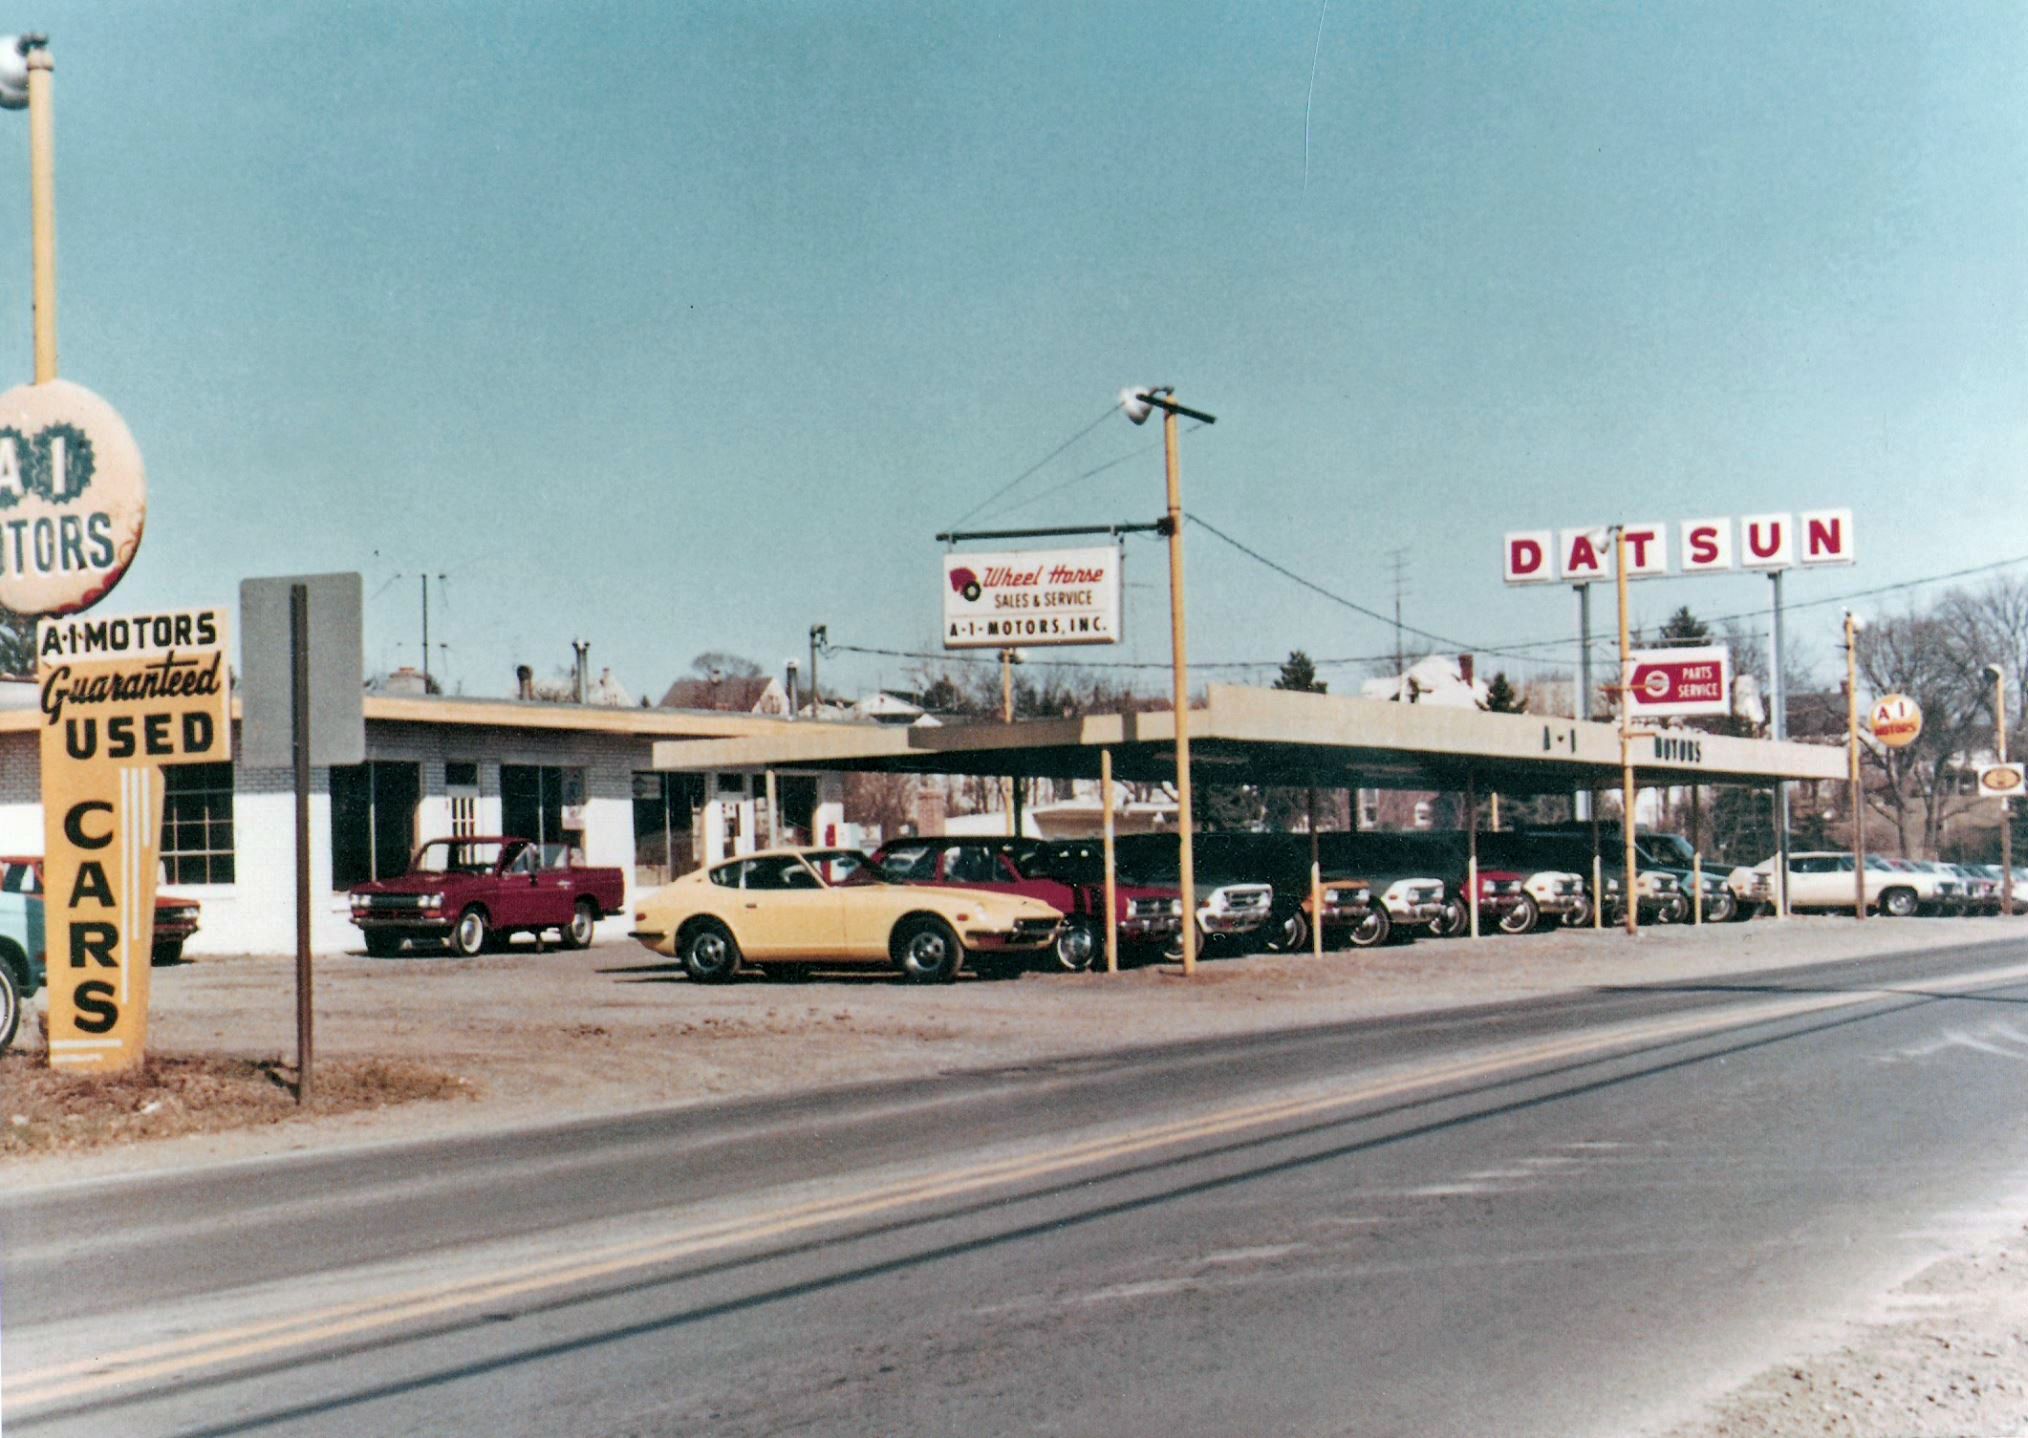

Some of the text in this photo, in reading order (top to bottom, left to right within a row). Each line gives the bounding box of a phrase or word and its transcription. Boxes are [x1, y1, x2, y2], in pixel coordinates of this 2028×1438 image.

[0, 511, 115, 577] TORS
[1511, 517, 1842, 575] DATSUN
[982, 564, 1105, 589] Wheel Horse
[995, 590, 1093, 609] SALES & SERVICE
[1070, 617, 1107, 633] INC.
[41, 650, 222, 726] Guaranteed
[1678, 682, 1718, 698] SERVICE
[1682, 665, 1713, 680] PARTS
[65, 710, 214, 760] USED
[64, 800, 119, 1034] CARS
